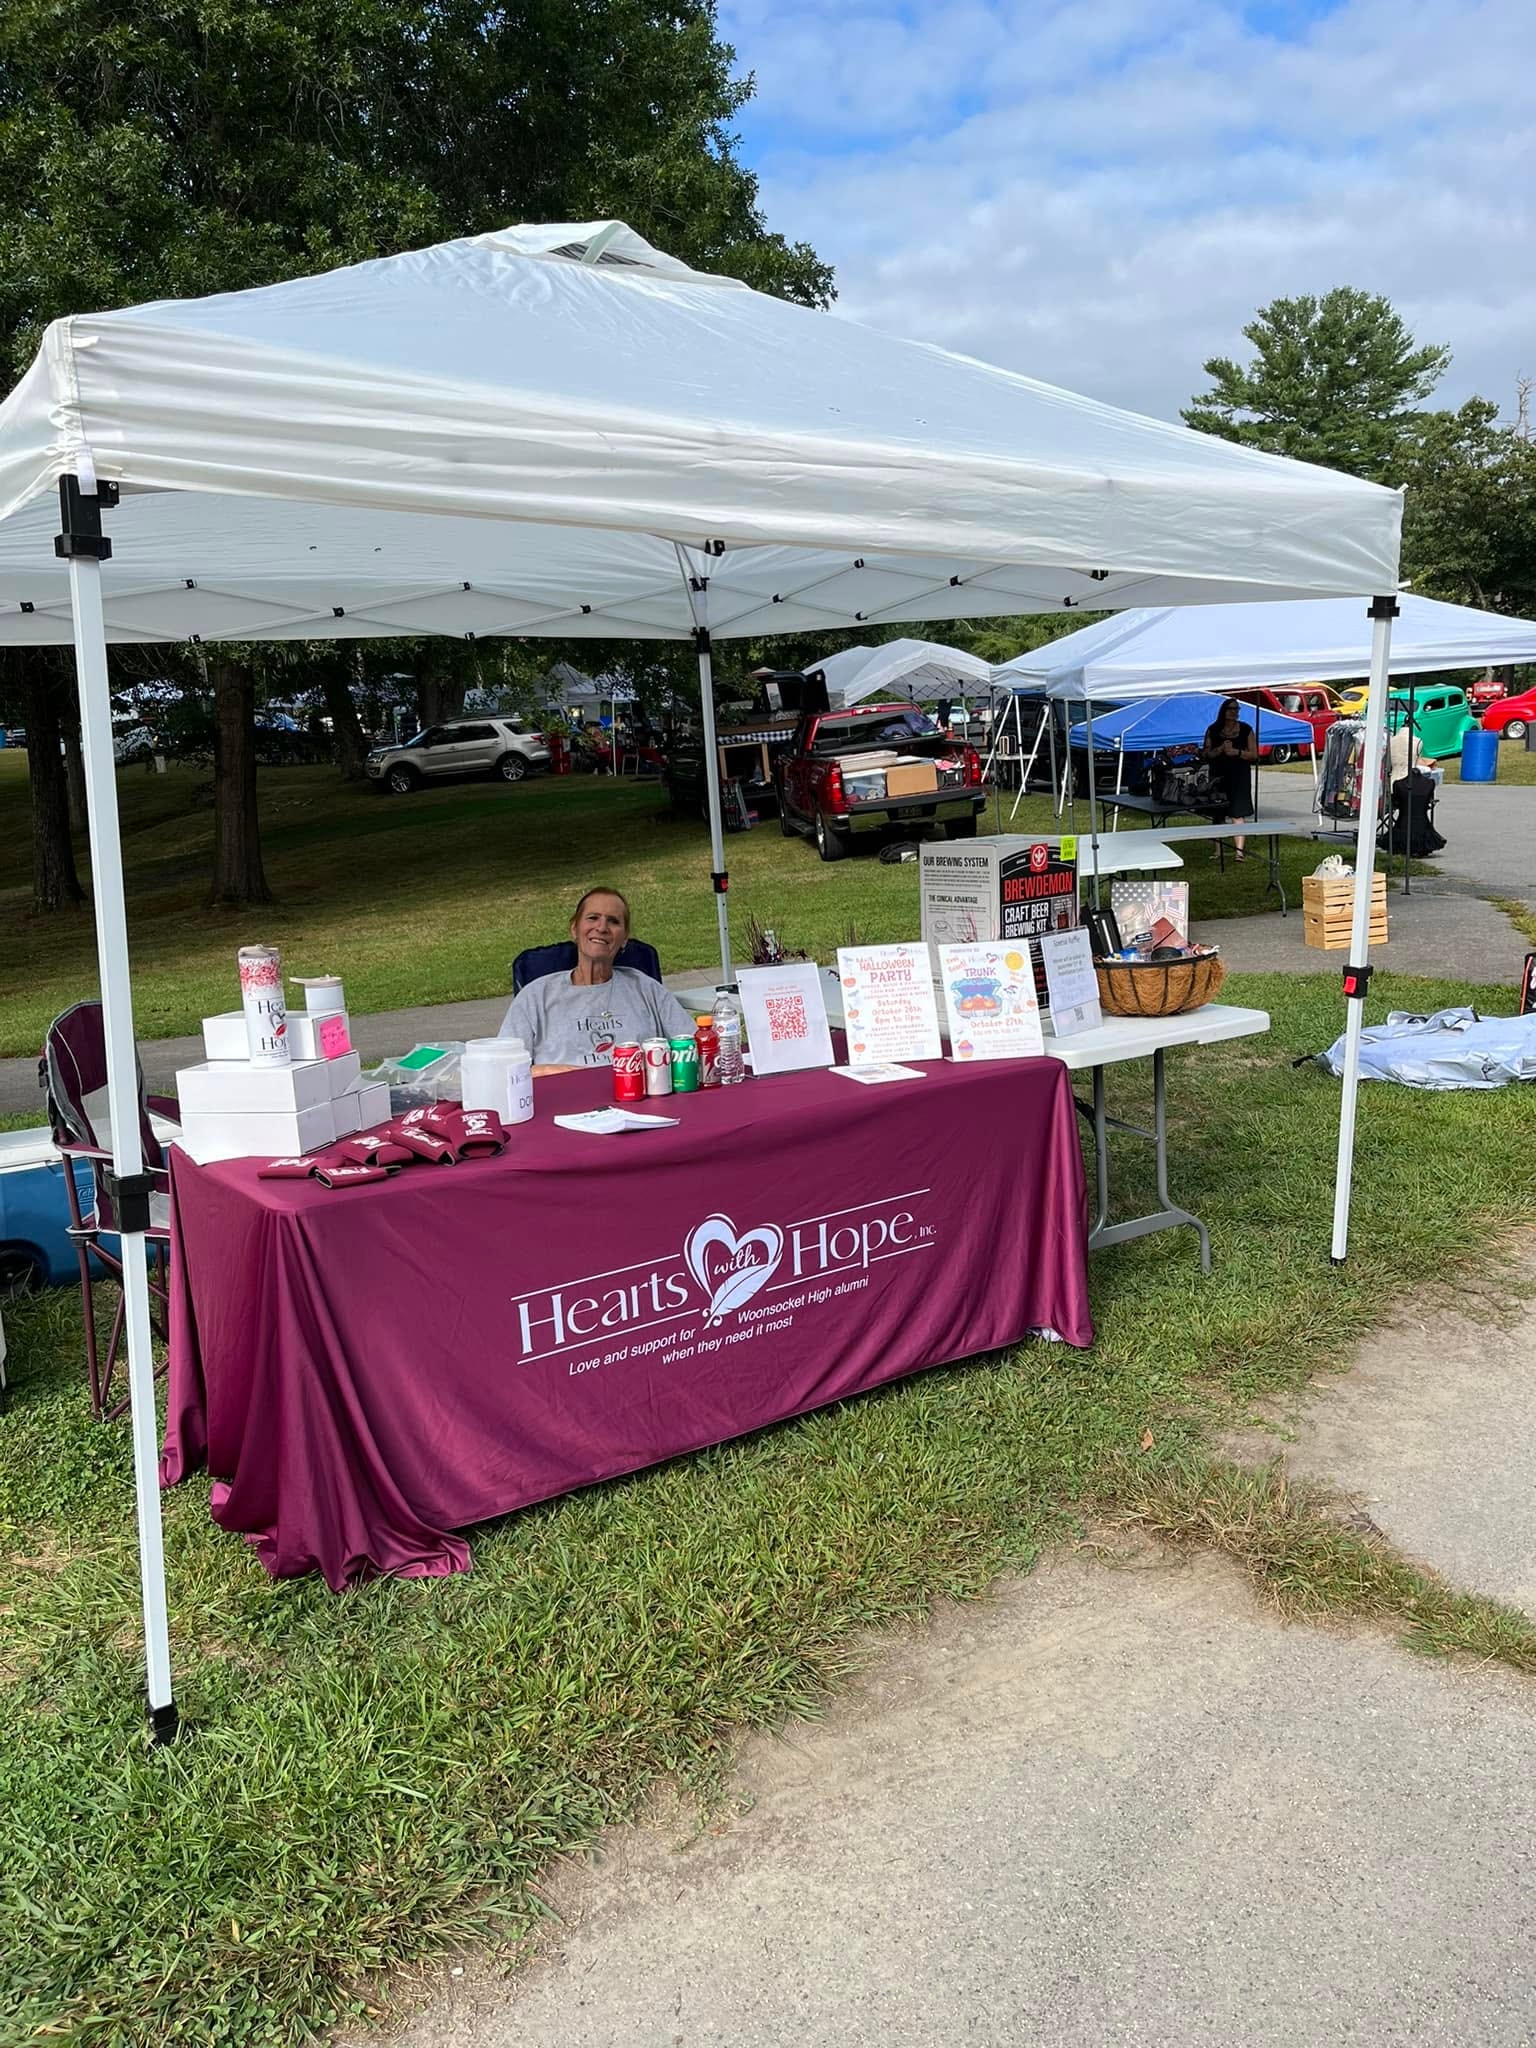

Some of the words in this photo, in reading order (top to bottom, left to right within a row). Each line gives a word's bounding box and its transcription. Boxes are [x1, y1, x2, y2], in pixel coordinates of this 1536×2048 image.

[923, 856, 935, 867] OUR
[936, 856, 963, 867] BREWING
[964, 857, 989, 868] SYSTEM
[1004, 872, 1073, 902] BREWDEMON
[954, 896, 978, 904] ADVANTAGE
[1005, 905, 1030, 923] CRAFT
[1031, 902, 1049, 920] BEER
[1004, 920, 1035, 938] BREWING
[1036, 919, 1047, 932] KIT
[859, 957, 915, 972] HALLOWEEN
[964, 967, 997, 978] TRUNK
[577, 1018, 624, 1032] Hearts
[518, 1272, 689, 1354] Hearts
[714, 1244, 760, 1275] with
[918, 1224, 938, 1238] Inc.
[569, 1358, 601, 1376] Love
[603, 1346, 628, 1365] and
[630, 1336, 677, 1355] support
[679, 1328, 697, 1343] for
[737, 1294, 806, 1324] Woonsocket
[808, 1287, 832, 1304] High
[834, 1275, 870, 1296] alumni
[662, 1346, 695, 1365] when
[697, 1336, 722, 1352] they
[725, 1328, 754, 1345] need
[756, 1324, 764, 1336] it
[765, 1315, 794, 1334] most
